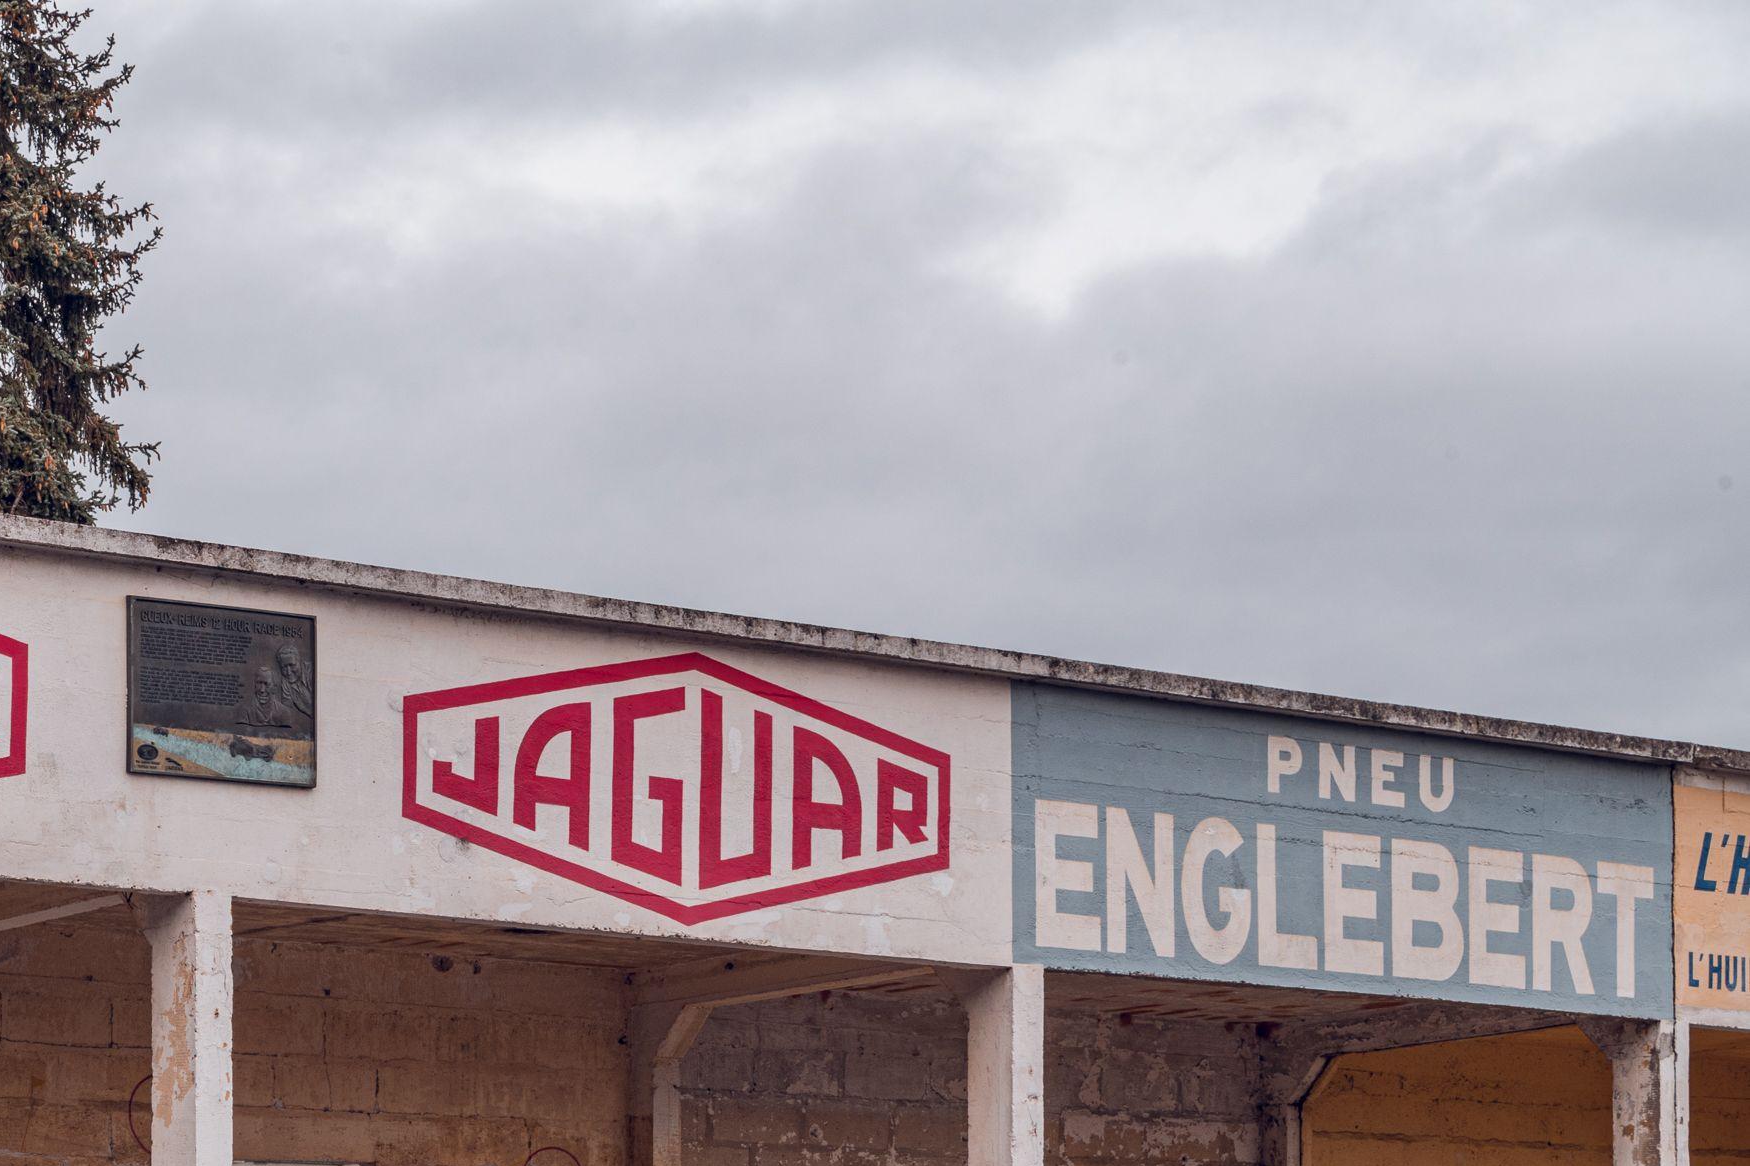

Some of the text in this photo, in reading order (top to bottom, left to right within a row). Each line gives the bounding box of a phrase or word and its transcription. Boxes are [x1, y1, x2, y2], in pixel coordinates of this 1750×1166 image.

[224, 618, 251, 633] HOUR
[253, 621, 280, 636] RACE
[432, 686, 929, 891] JAGUAR
[1266, 735, 1455, 813] PNEU
[1034, 798, 1655, 998] ENGLEBERT
[1688, 952, 1750, 993] L'HUI
